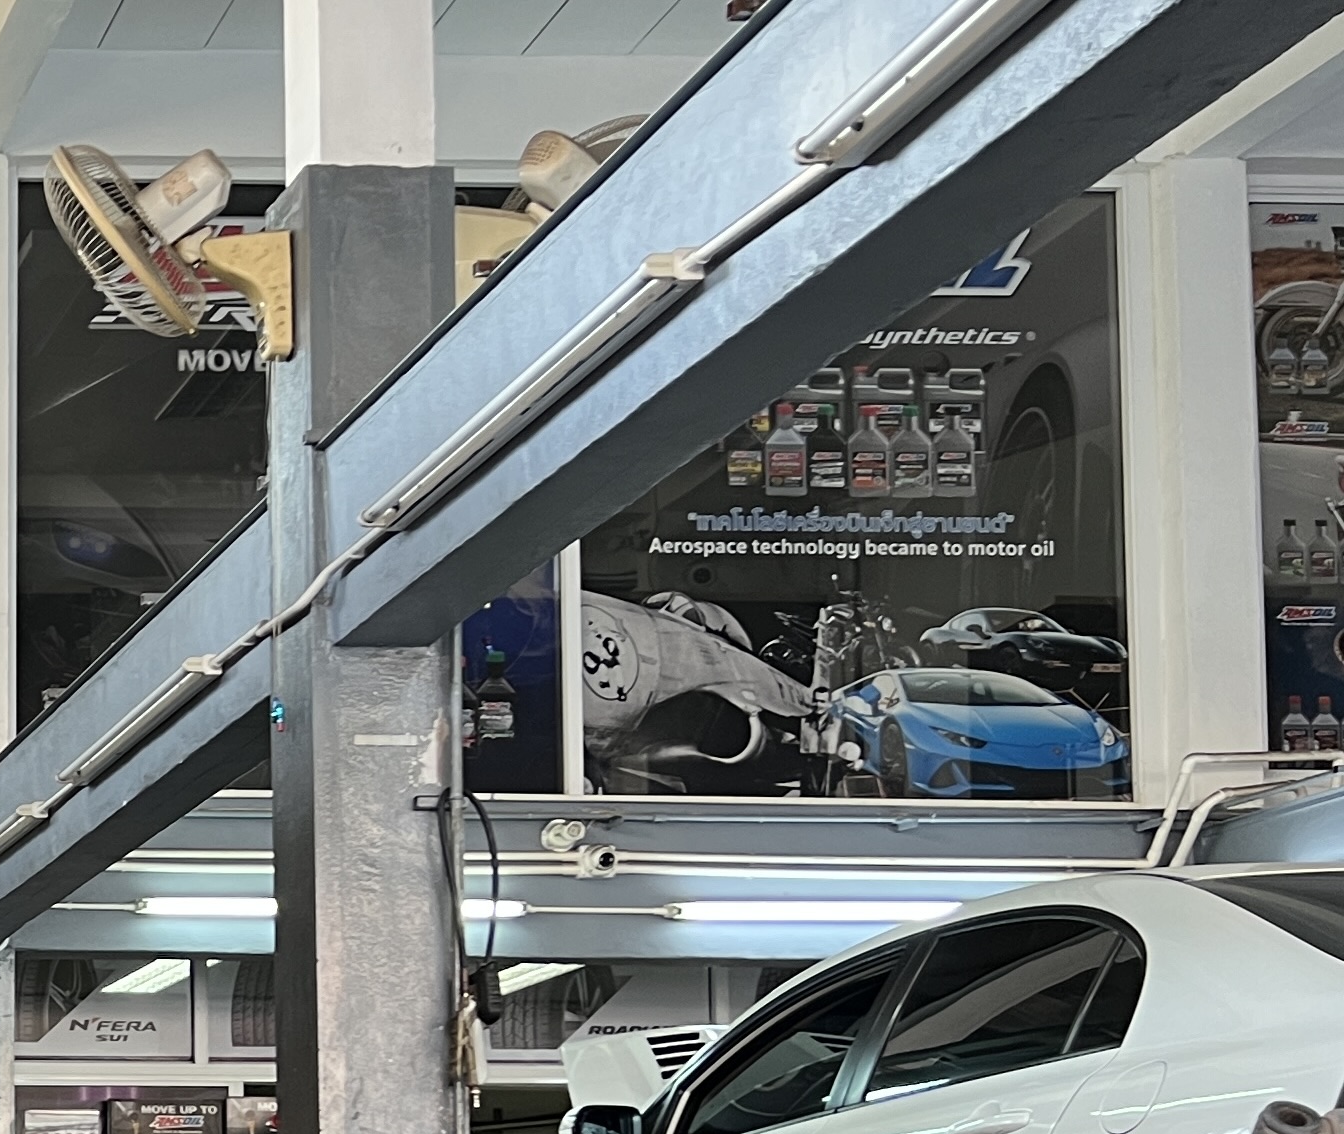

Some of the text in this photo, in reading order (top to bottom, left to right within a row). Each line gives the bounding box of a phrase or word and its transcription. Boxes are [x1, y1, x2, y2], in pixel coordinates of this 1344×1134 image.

[1265, 212, 1320, 225] AMSOIL
[1272, 422, 1328, 434] AMSOIL
[649, 537, 1055, 559] Aerospace technology became to motor oil
[1279, 606, 1335, 618] AMSOIL
[588, 1025, 662, 1035] ROAD
[140, 1105, 218, 1115] MOVE UP TO
[256, 1102, 278, 1112] MO
[151, 1116, 204, 1127] AMSOIL
